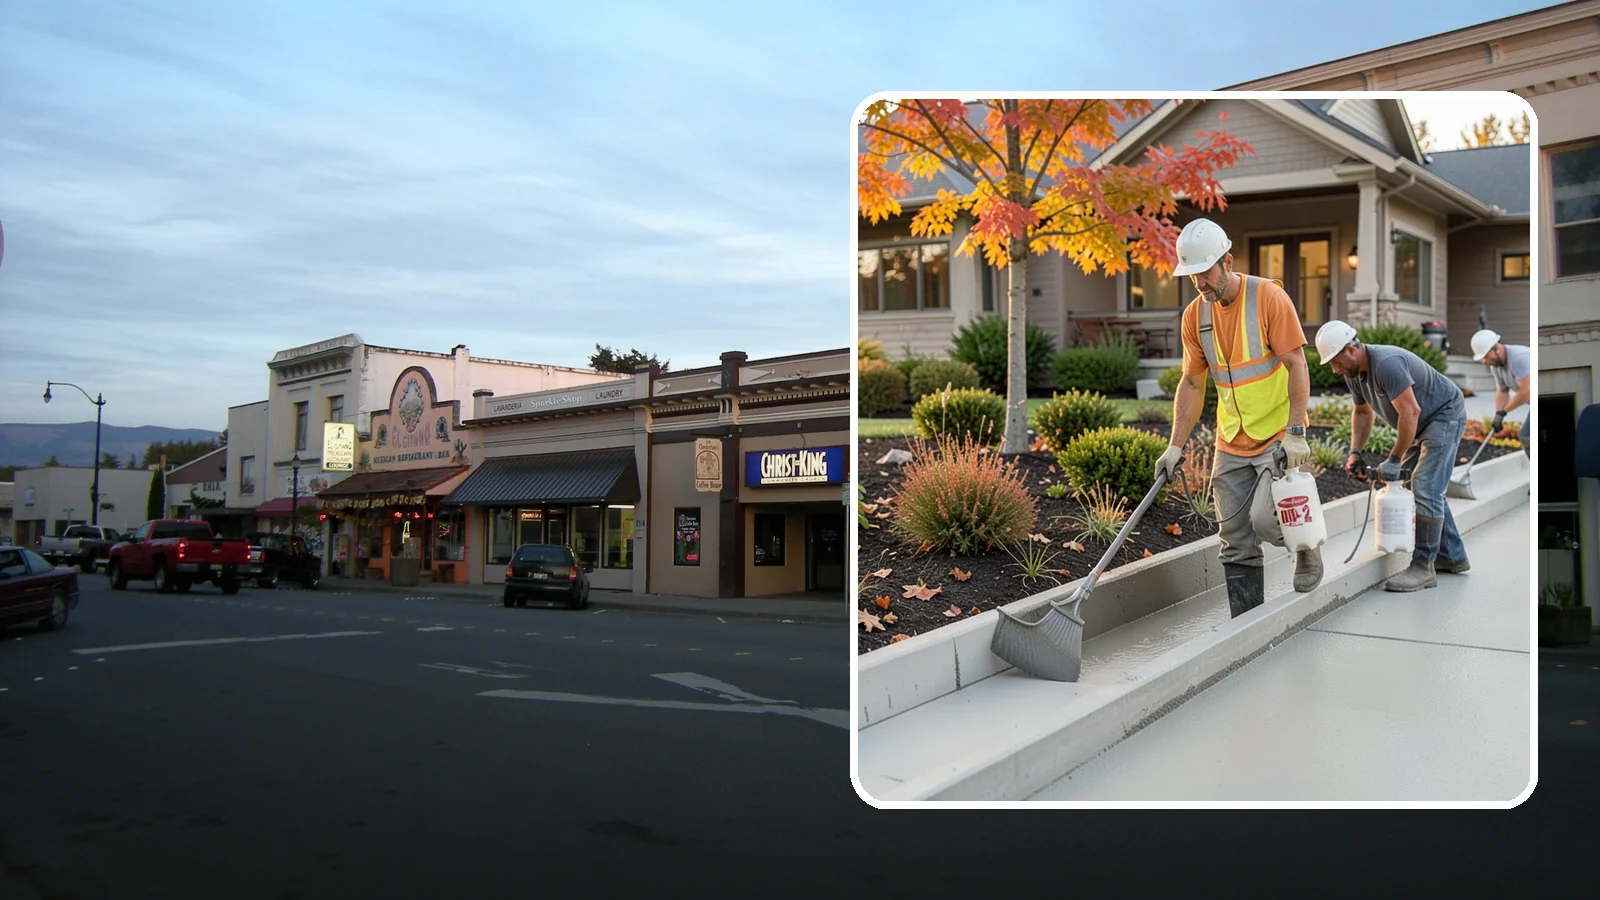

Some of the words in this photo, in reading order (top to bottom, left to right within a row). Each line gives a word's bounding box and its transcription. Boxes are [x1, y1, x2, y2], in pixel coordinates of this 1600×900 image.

[595, 389, 623, 400] LAUNDRY
[493, 402, 522, 412] LAVANDERIA
[374, 455, 396, 464] MEXICAN
[398, 451, 433, 462] RESTAURANT
[438, 450, 450, 459] BAR
[760, 452, 797, 478] CHRIST
[800, 450, 828, 476] KING
